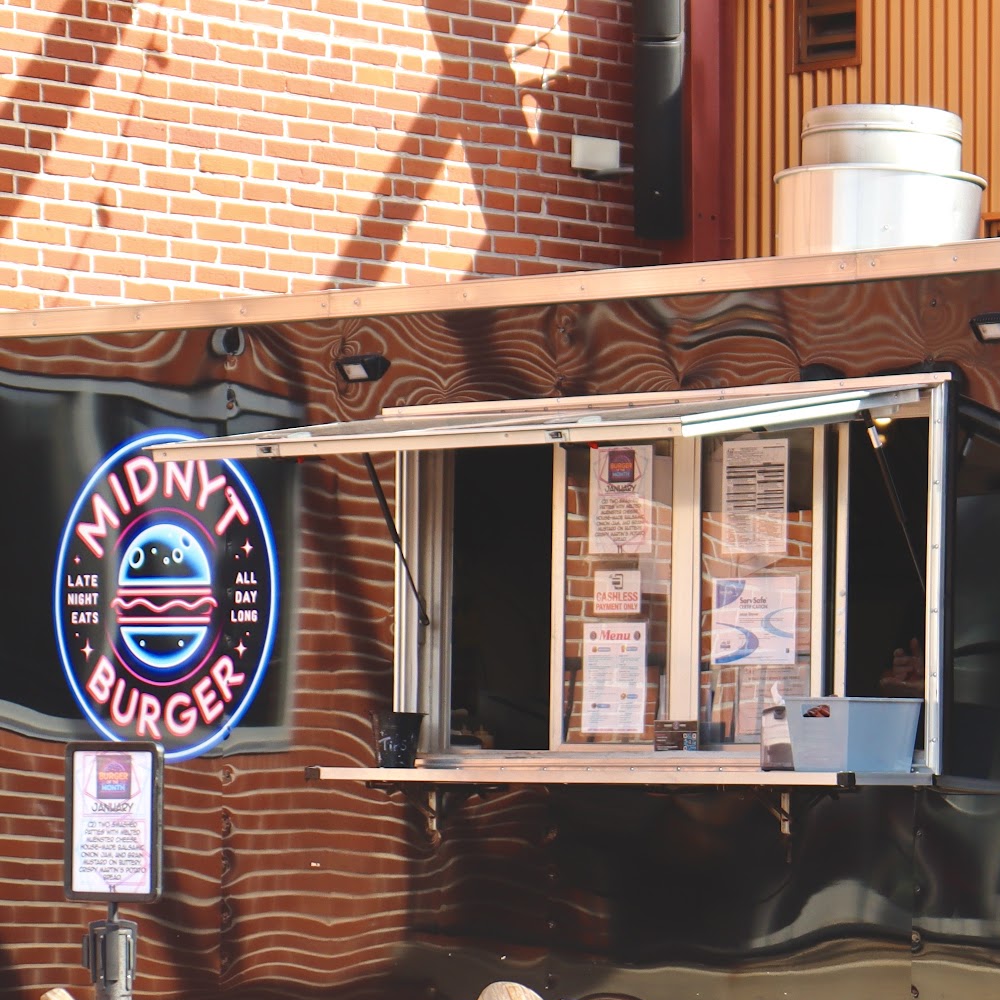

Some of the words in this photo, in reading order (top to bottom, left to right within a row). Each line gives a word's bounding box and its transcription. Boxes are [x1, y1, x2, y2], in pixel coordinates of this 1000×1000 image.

[75, 456, 250, 558] MIDNYT
[67, 574, 98, 587] LATE
[235, 571, 257, 585] ALL
[67, 593, 99, 606] NIGHT
[234, 590, 258, 604] DAY
[596, 591, 638, 602] CASHLESS
[71, 611, 99, 624] EATS
[231, 610, 258, 623] LONG
[600, 630, 631, 641] Menu
[85, 654, 245, 740] BURGER
[98, 771, 129, 780] BURGER
[91, 802, 134, 812] JANUARY
